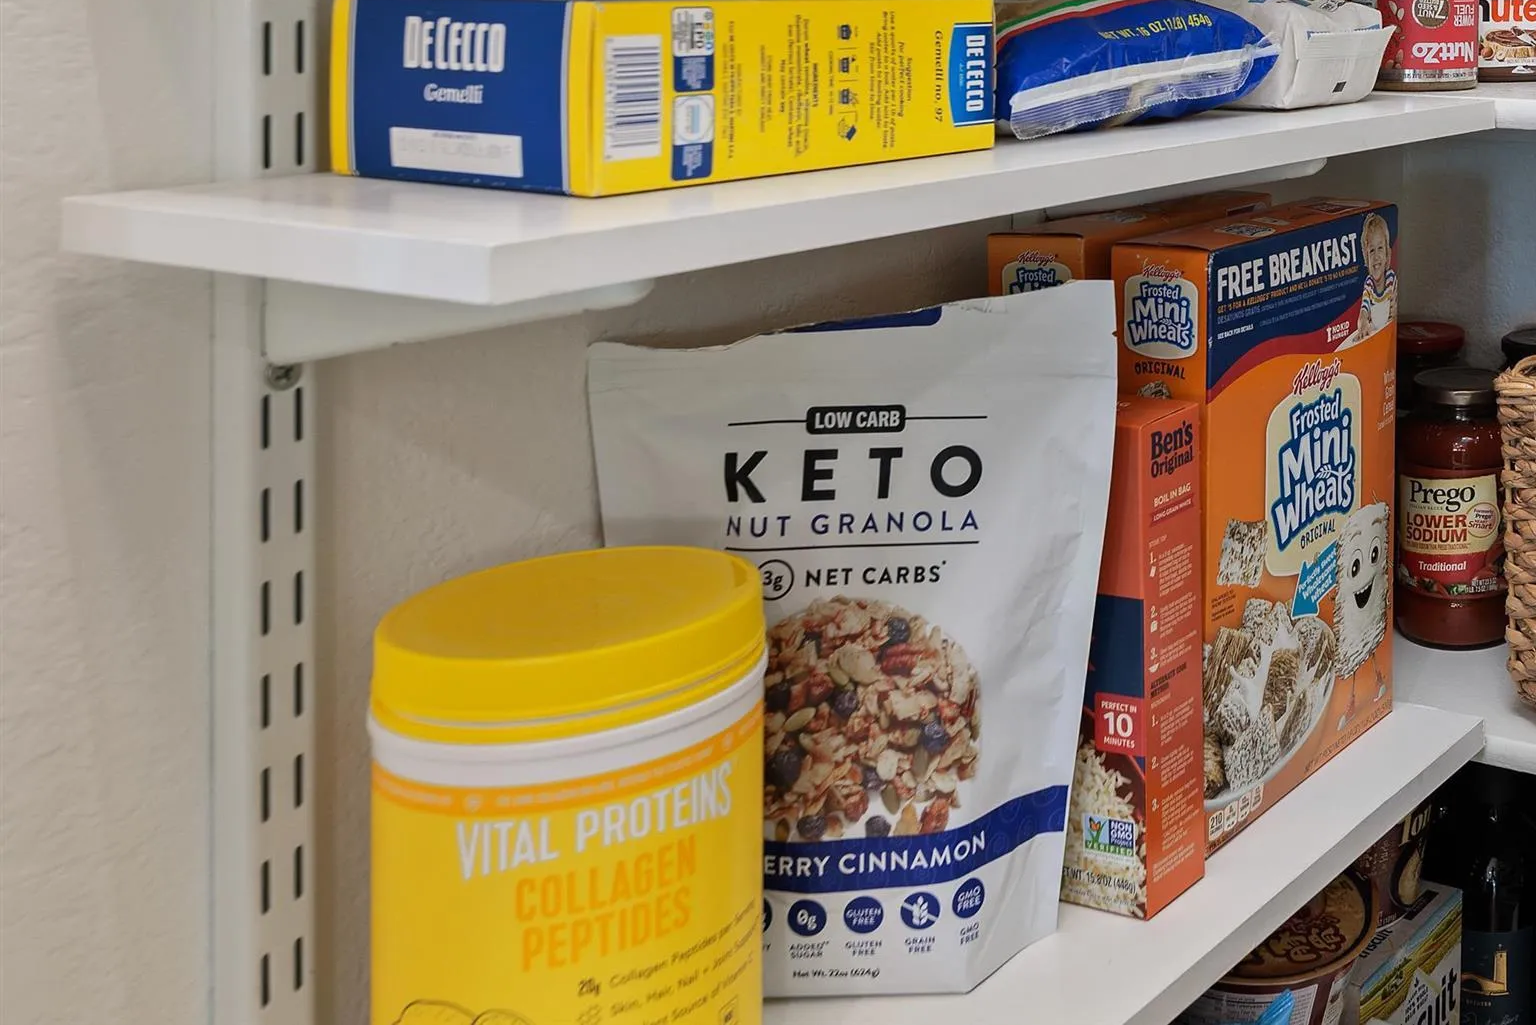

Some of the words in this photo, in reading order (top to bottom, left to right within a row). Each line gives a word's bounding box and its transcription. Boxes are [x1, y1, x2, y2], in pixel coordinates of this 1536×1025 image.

[1187, 13, 1213, 28] 454g
[423, 82, 484, 105] Gemelli
[966, 59, 986, 112] CECCO
[1018, 270, 1054, 283] Frosted
[1217, 257, 1264, 302] FREE
[1269, 232, 1357, 286] BREAKFAST
[1142, 284, 1179, 300] Frosted
[1134, 297, 1188, 324] Mini
[1129, 319, 1191, 347] Wheats
[1135, 361, 1185, 379] ORIGINAL
[1294, 359, 1341, 395] Kellogg's
[815, 412, 852, 429] LOW
[856, 410, 900, 428] CARB
[1292, 393, 1340, 439] Frosted
[1151, 420, 1193, 460] Ben's
[1151, 446, 1193, 478] Original
[1282, 416, 1349, 497] Mini
[725, 445, 983, 503] KETO
[1154, 489, 1169, 508] BOIL
[1177, 483, 1192, 499] BAG
[1276, 466, 1352, 544] Wheats
[1409, 480, 1475, 512] Prego
[727, 516, 791, 537] NUT
[811, 510, 979, 535] GRANOLA
[1407, 512, 1467, 528] LOWER
[1468, 521, 1493, 530] Smart
[1300, 519, 1336, 550] ORIGINAL
[1406, 526, 1467, 543] SODIUM
[1419, 561, 1466, 571] Traditional
[763, 570, 783, 591] 3g
[805, 568, 852, 586] NET
[1101, 701, 1129, 713] PERFECT
[1130, 706, 1137, 714] IN
[1103, 712, 1134, 737] 10
[1103, 736, 1135, 749] MINUTES
[454, 819, 560, 882] VITAL
[574, 765, 732, 854] PROTEINS
[1111, 821, 1133, 833] NON
[1110, 830, 1133, 841] GMO
[838, 831, 985, 875] CINNAMON
[1085, 841, 1133, 857] VERIFIED
[515, 834, 697, 923] COLLAGEN
[957, 887, 981, 903] GMO
[846, 907, 881, 919] GLUTEN
[957, 897, 981, 913] FREE
[797, 909, 817, 930] 0g
[852, 917, 875, 926] FREE
[521, 885, 692, 974] PEPTIDES
[959, 923, 979, 937] GMO
[959, 932, 979, 946] FREE
[845, 940, 882, 950] GLUTEN
[905, 937, 936, 946] GRAIN
[908, 944, 932, 954] FREE
[790, 951, 823, 960] SUGAR
[852, 948, 876, 957] FREE
[609, 958, 668, 989] Collagen
